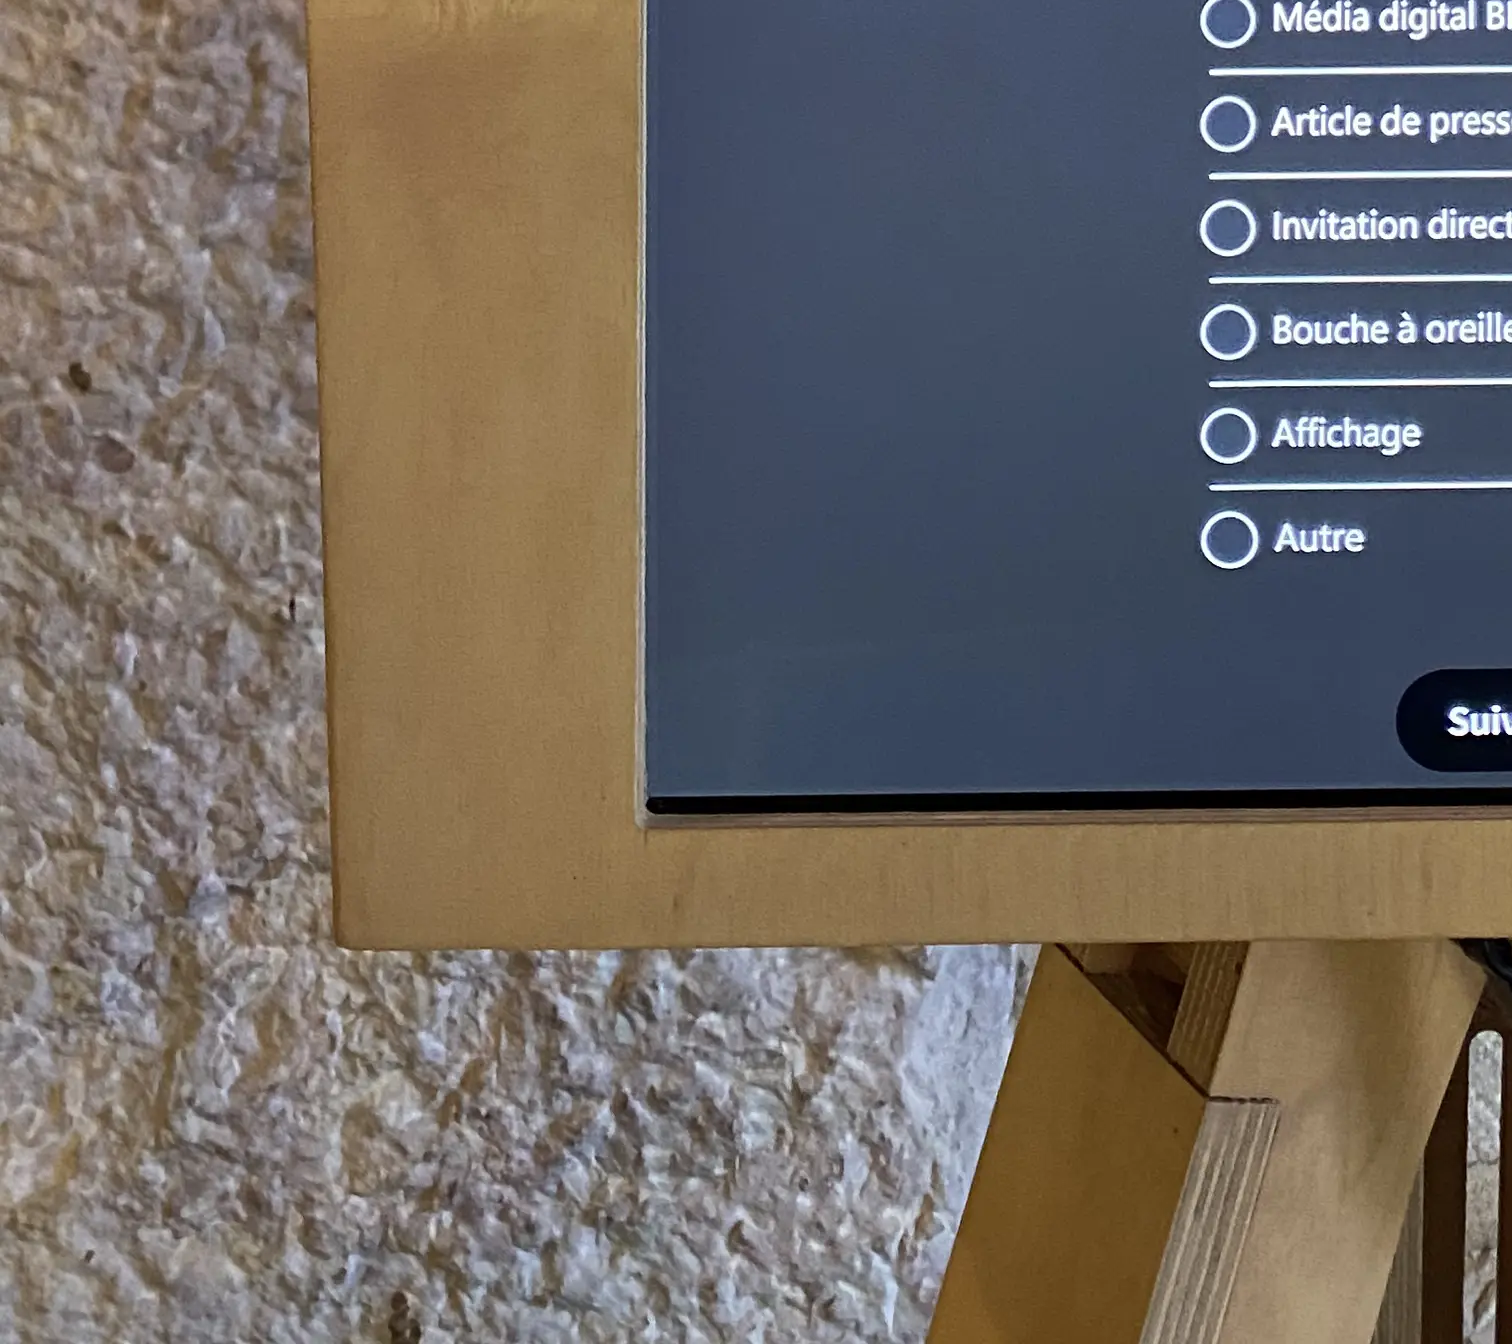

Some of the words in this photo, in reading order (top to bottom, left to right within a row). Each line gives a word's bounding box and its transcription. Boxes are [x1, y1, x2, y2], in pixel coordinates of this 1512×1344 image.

[1272, 0, 1371, 33] Média
[1271, 104, 1373, 138] Article
[1379, 103, 1422, 137] de
[1272, 207, 1420, 242] Invitation
[1272, 312, 1390, 345] Bouche
[1396, 311, 1418, 344] à
[1271, 415, 1423, 456] Affichage
[1273, 522, 1367, 554] Autre
